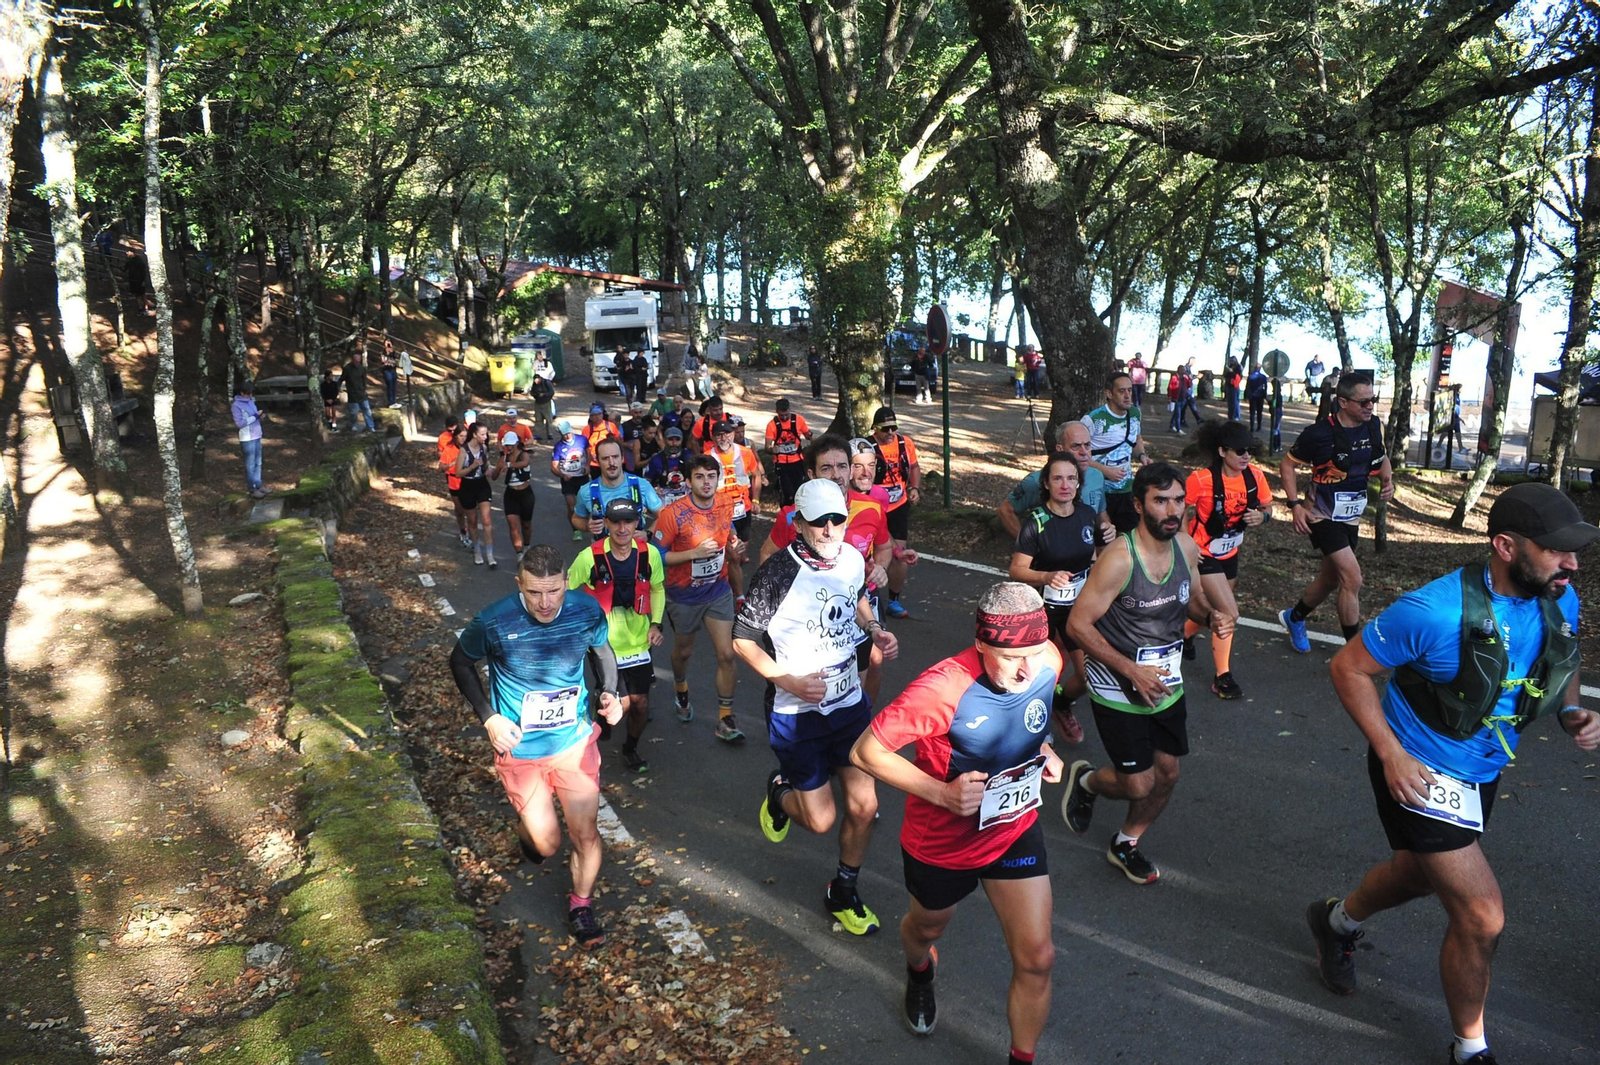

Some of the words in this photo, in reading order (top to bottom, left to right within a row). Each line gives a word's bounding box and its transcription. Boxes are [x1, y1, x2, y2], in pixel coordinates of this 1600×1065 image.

[1344, 504, 1360, 515] 115
[1221, 540, 1236, 552] 114
[701, 562, 719, 574] 123
[1058, 587, 1077, 599] 171
[1138, 594, 1177, 608] Dentalnova
[834, 674, 852, 695] 101
[539, 705, 564, 721] 124
[998, 785, 1031, 811] 216
[1002, 856, 1037, 868] HOKO
